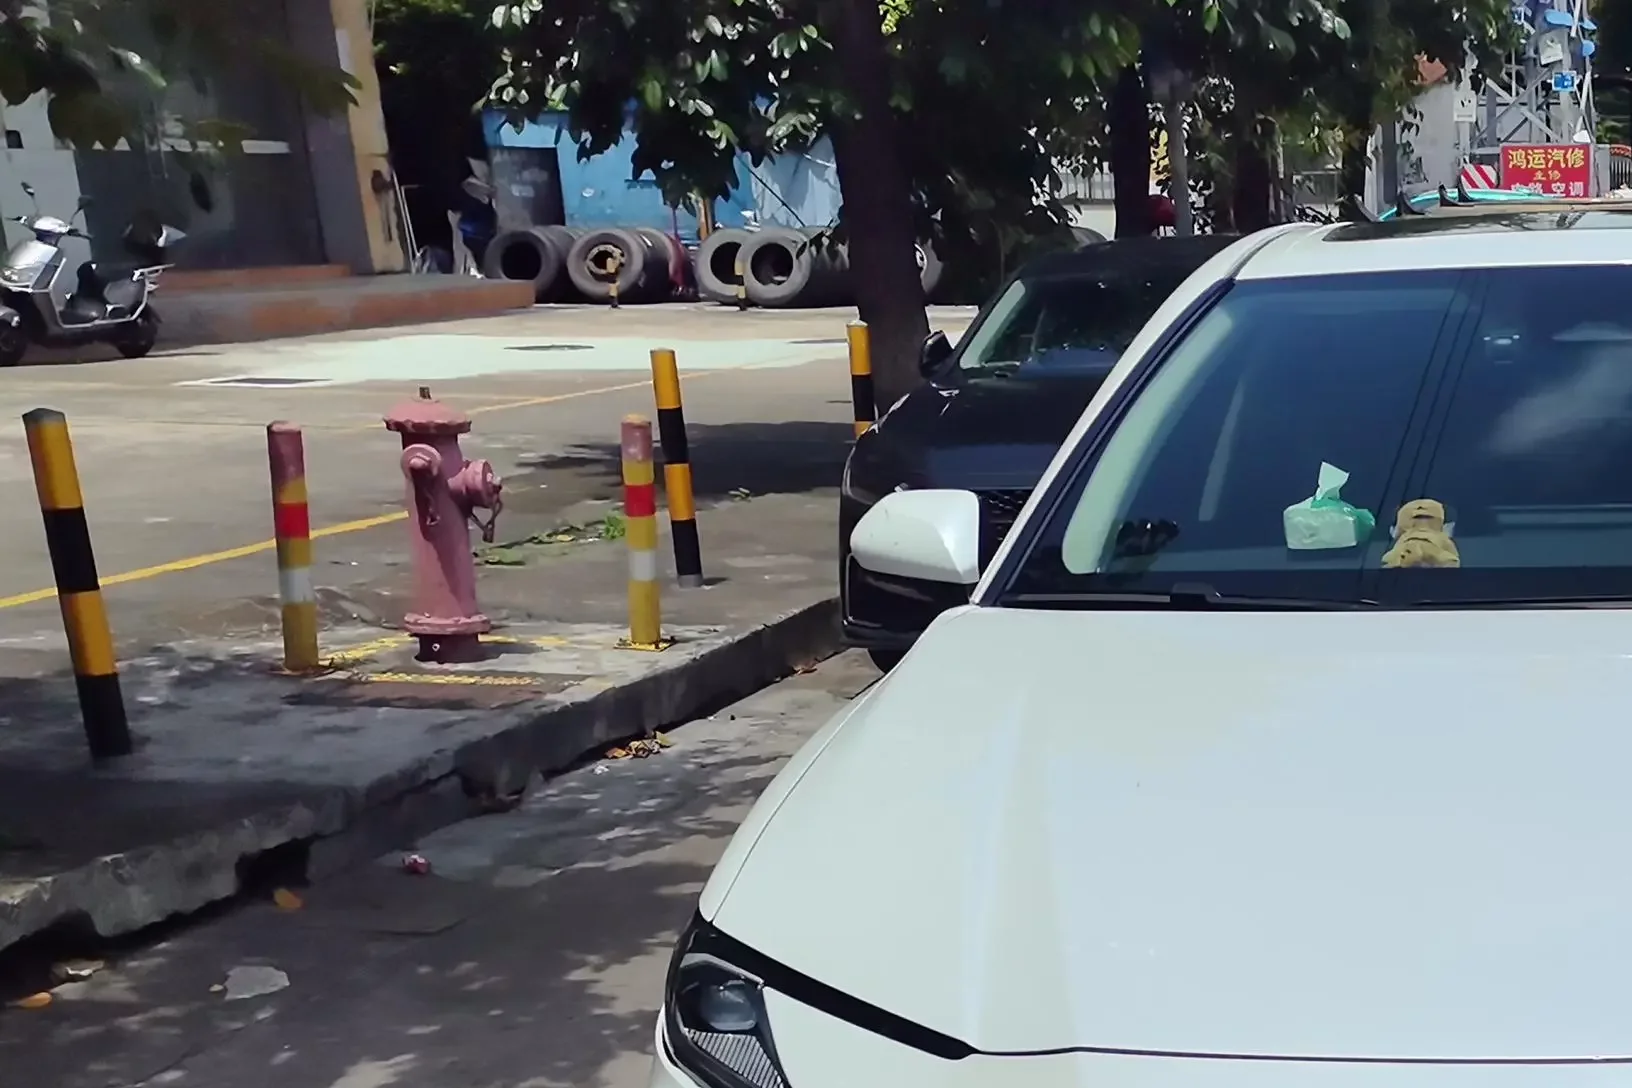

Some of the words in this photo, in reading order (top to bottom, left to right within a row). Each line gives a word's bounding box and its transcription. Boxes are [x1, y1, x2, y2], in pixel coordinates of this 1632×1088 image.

[1508, 148, 1584, 169] 鸿运汽修
[1551, 182, 1584, 197] 空调
